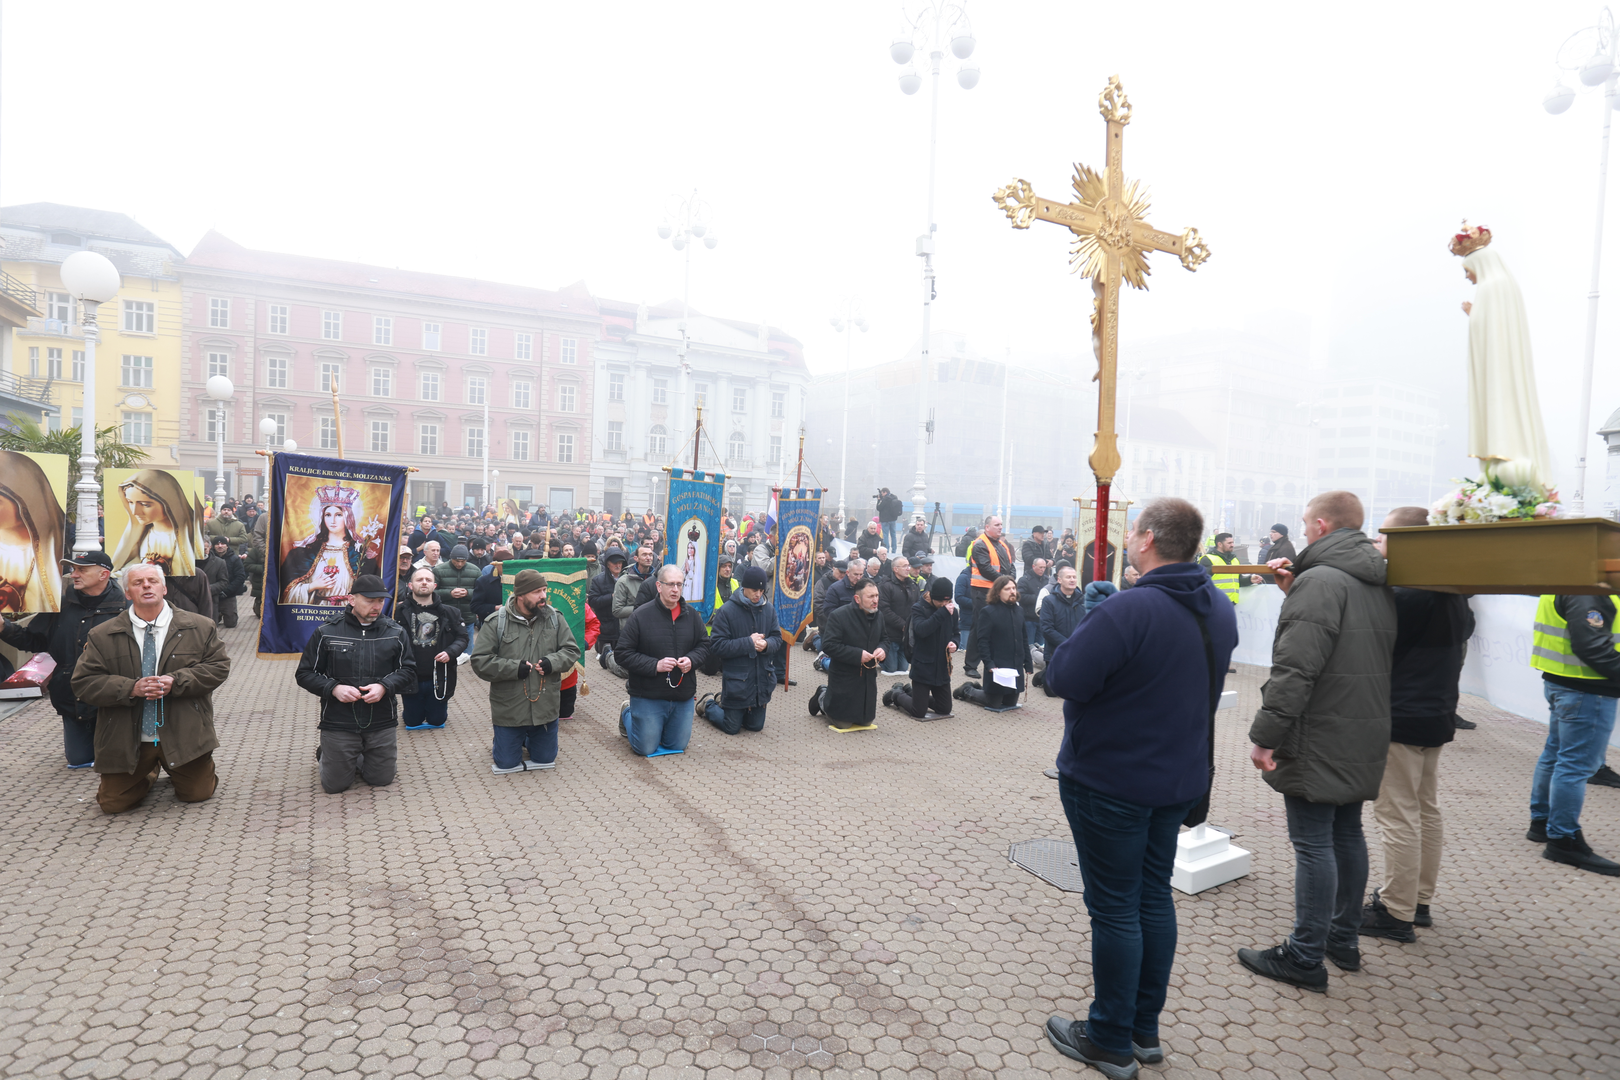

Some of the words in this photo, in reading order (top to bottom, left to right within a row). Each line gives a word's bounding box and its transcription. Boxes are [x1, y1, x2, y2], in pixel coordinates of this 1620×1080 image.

[289, 465, 321, 475] KRALJICE
[322, 469, 353, 479] KRUNICE,
[672, 491, 692, 504] GOSPA
[693, 502, 703, 510] ZA
[703, 504, 714, 516] NAS
